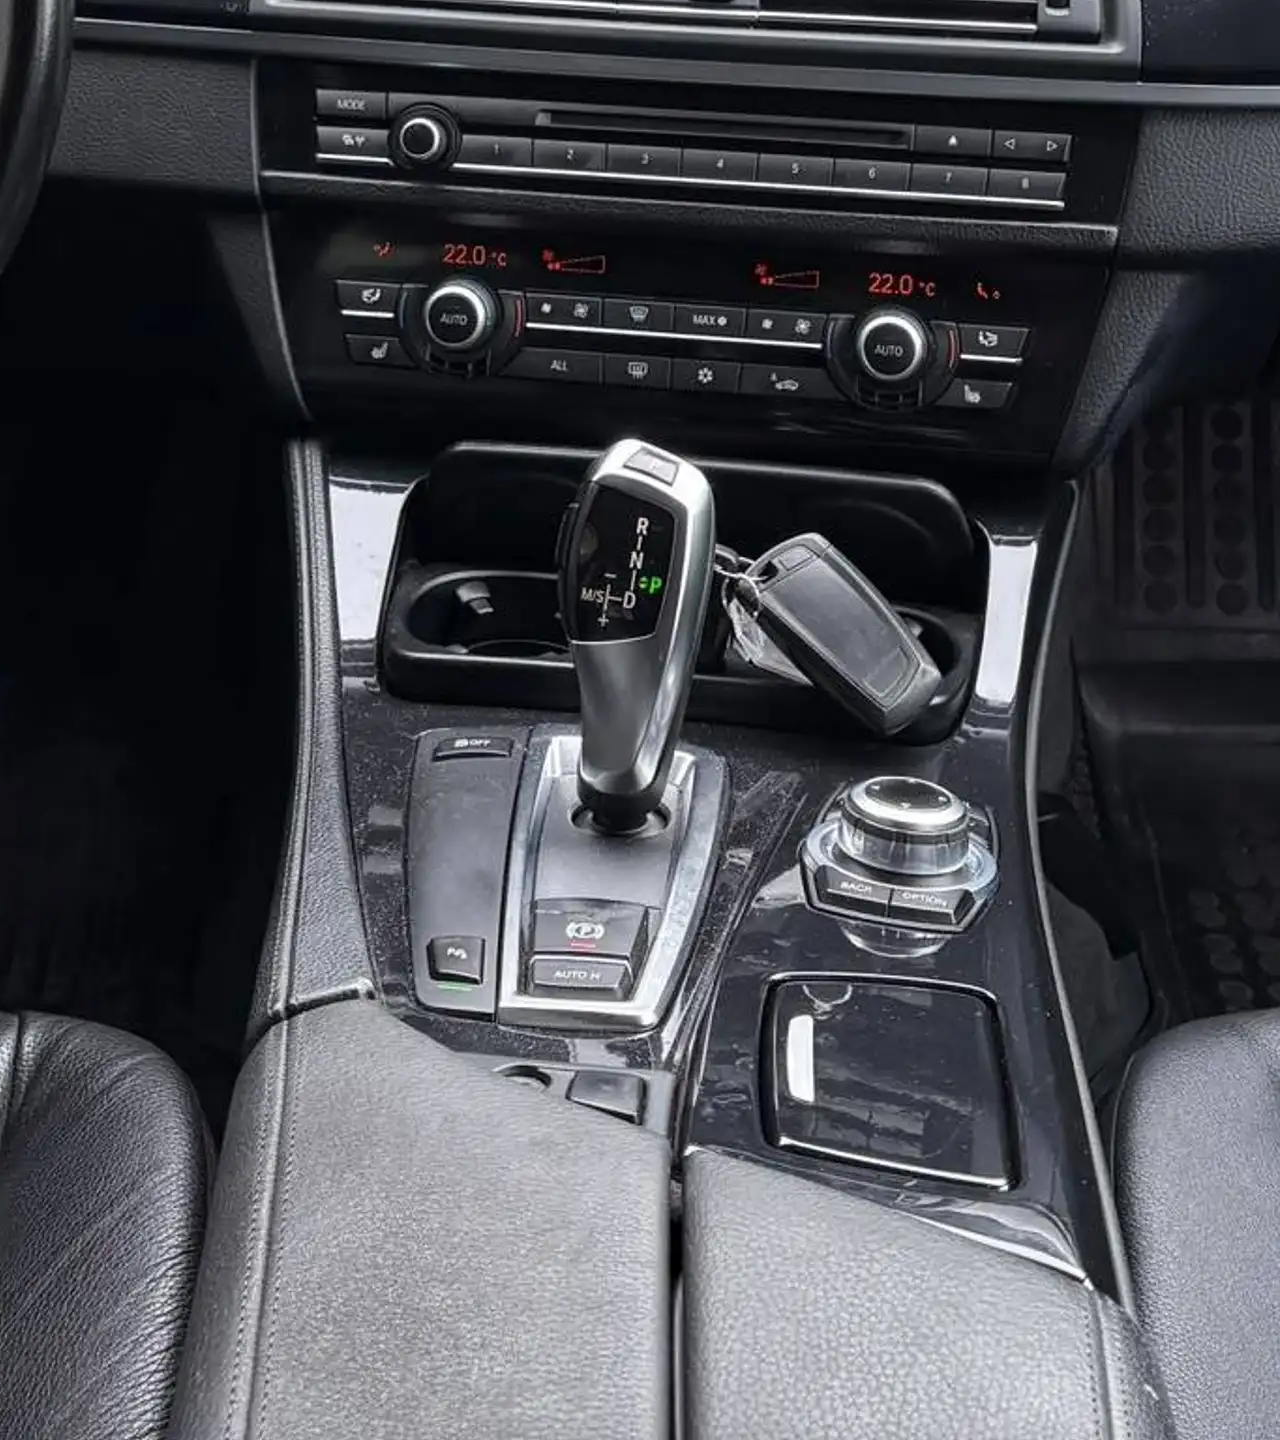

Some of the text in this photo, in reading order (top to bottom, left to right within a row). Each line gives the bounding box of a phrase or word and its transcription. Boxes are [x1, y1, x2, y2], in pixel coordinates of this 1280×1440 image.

[336, 98, 366, 111] MODE
[443, 243, 486, 266] 22.0
[868, 272, 913, 295] 22.0
[440, 313, 469, 326] AUTO
[693, 314, 717, 327] MAX
[874, 344, 904, 358] AUTO
[550, 360, 568, 372] ALL
[636, 517, 650, 536] R
[628, 550, 644, 570] N
[648, 576, 663, 594] P
[580, 586, 605, 603] M/S
[622, 591, 637, 609] D
[901, 891, 949, 908] OPTION
[554, 969, 588, 980] AUTO
